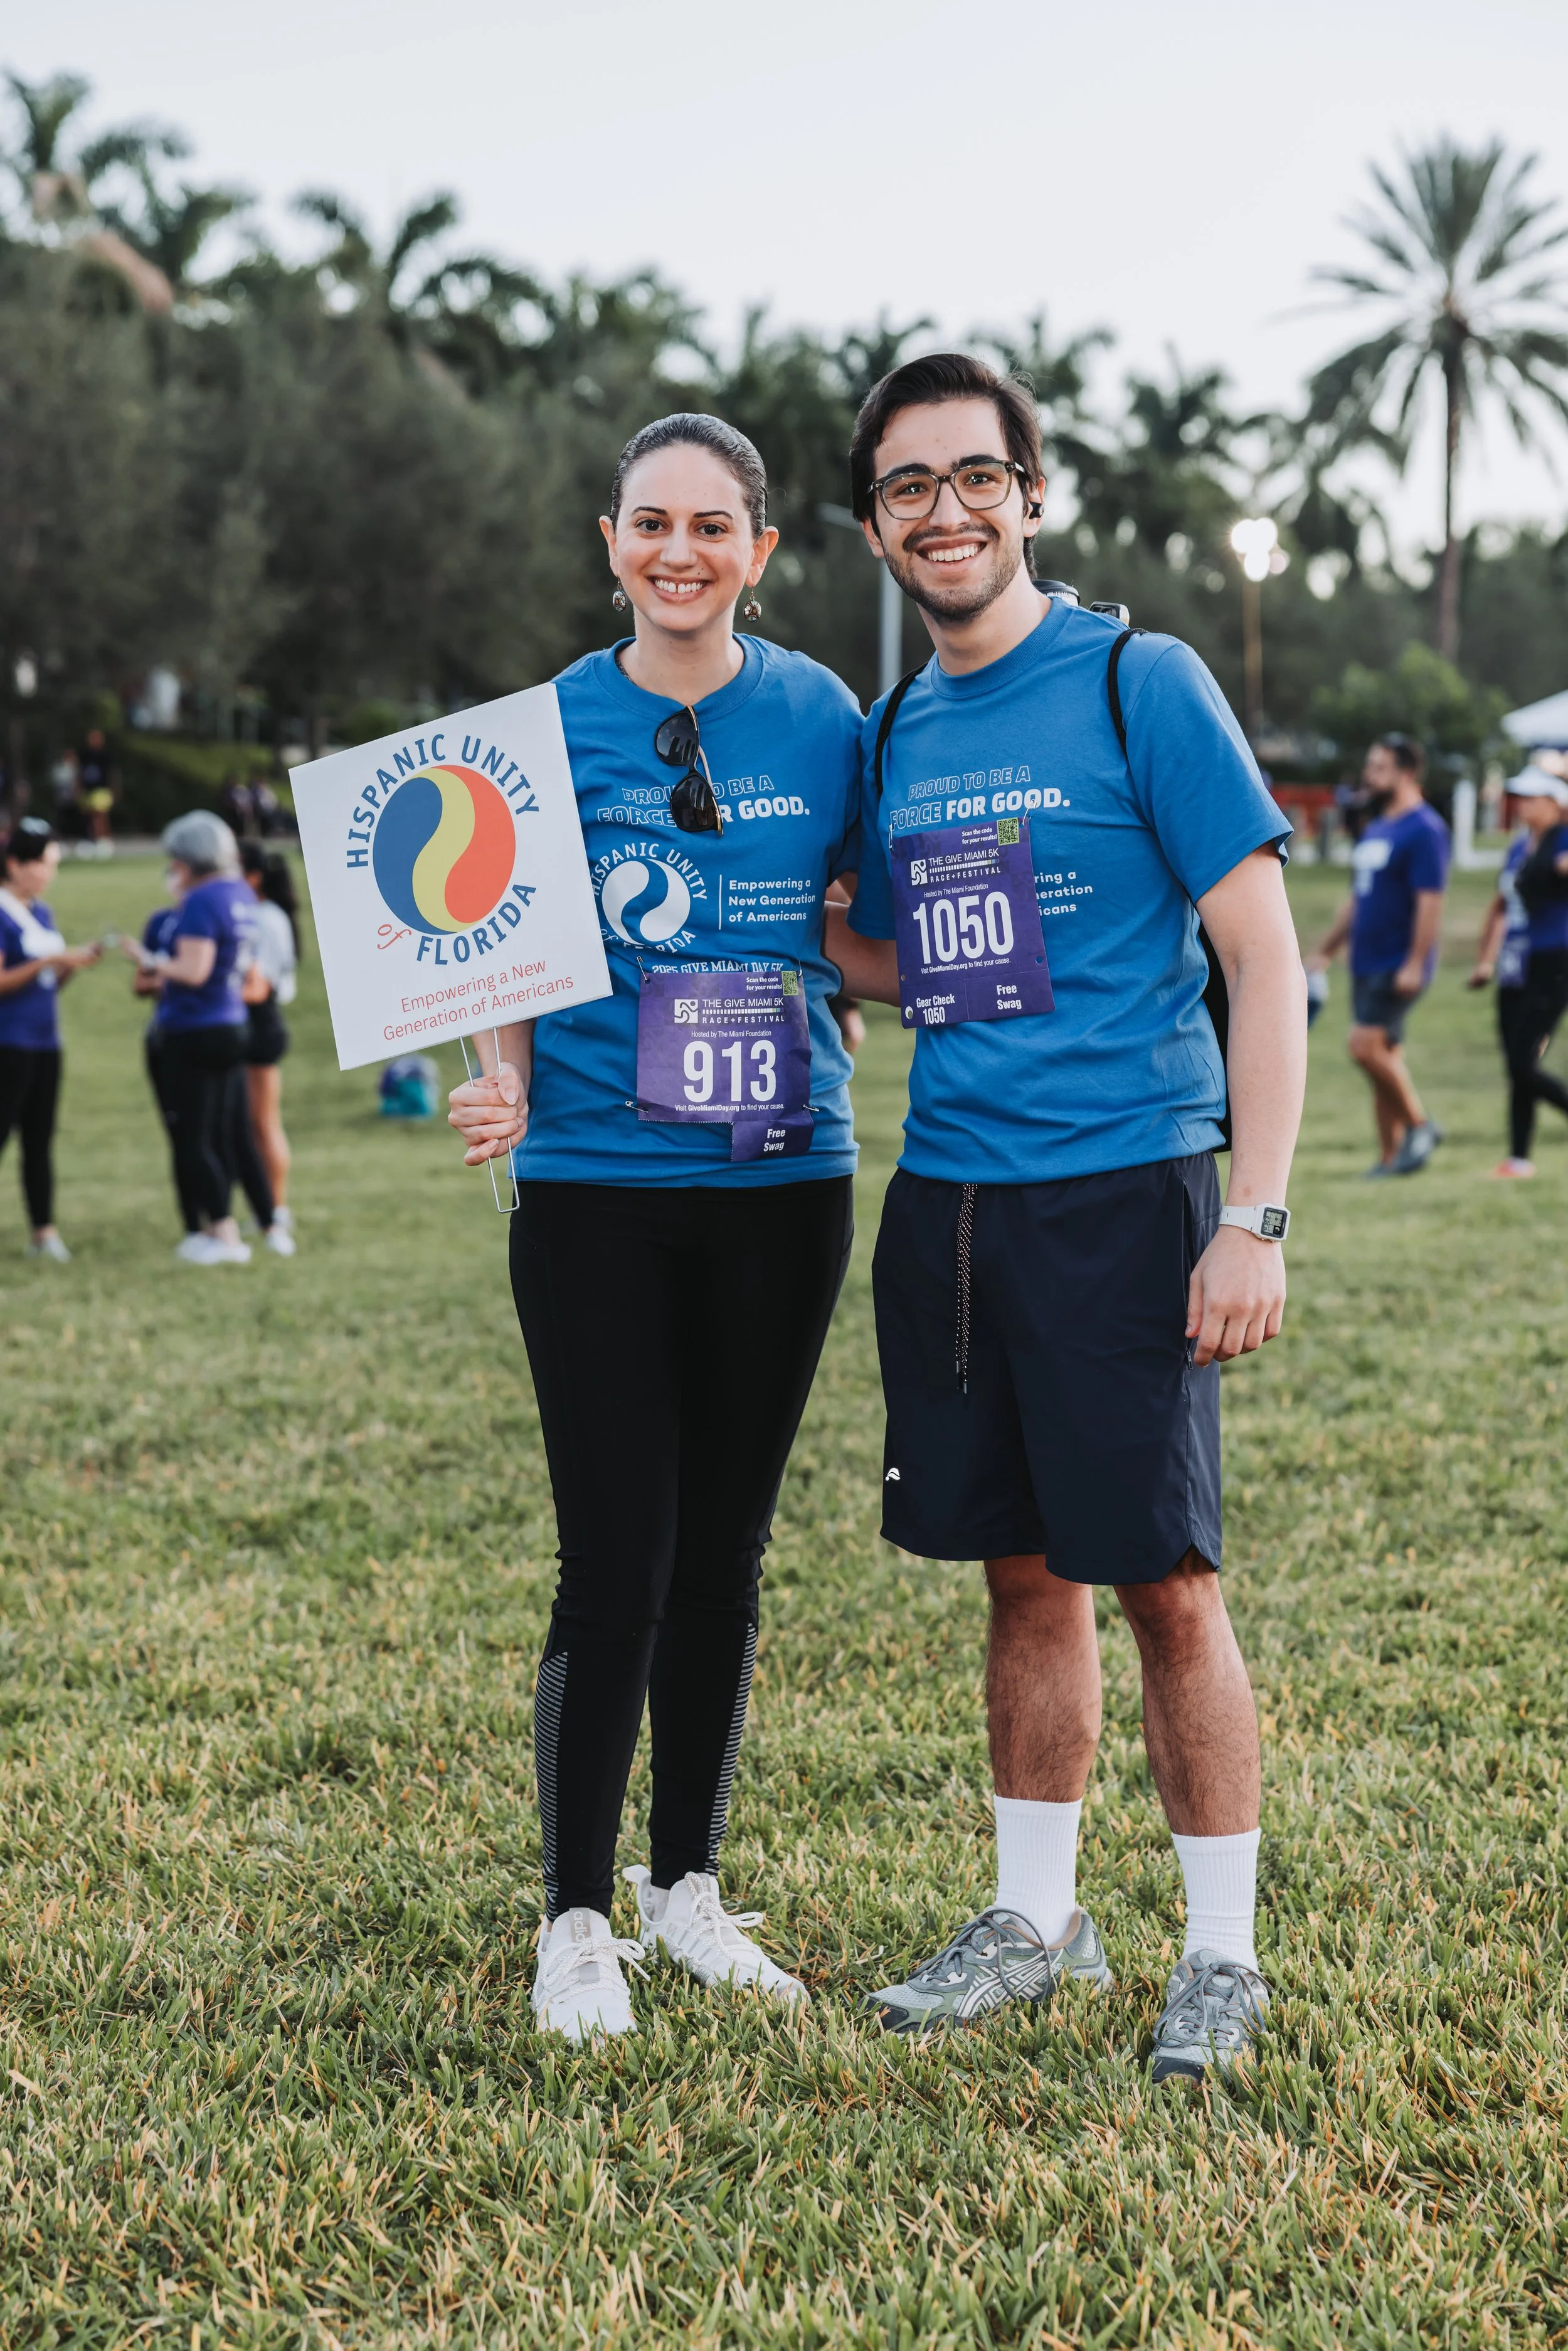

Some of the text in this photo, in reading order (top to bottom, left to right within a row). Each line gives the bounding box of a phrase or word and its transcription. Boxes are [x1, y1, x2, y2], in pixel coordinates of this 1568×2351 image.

[622, 786, 677, 804] PROU
[728, 777, 755, 796] BE
[759, 775, 775, 790] A
[908, 765, 1030, 801] PROUD TO BE A
[347, 734, 539, 868] HISPANIC UNITY
[597, 805, 677, 827] FORCE
[738, 796, 810, 820] GOOD.
[890, 787, 1071, 832] FORCE FOR GOOD.
[980, 834, 997, 842] results!
[928, 847, 999, 866] THE GIVE MIAMI 5K
[666, 849, 707, 900] UNITY
[1067, 871, 1076, 879] a
[729, 878, 811, 892] Empowering a
[923, 889, 938, 898] Hosted
[938, 888, 943, 897] by
[965, 883, 988, 892] Foundation
[729, 893, 815, 906] New Generation
[1036, 885, 1093, 900] eration
[729, 910, 807, 922] of Americans
[1038, 904, 1077, 916] icans
[377, 884, 537, 965] of FLORIDA
[913, 891, 1014, 965] 1050
[681, 962, 709, 974] GIVE
[710, 960, 748, 972] MIAMI
[751, 962, 770, 972] DAY
[770, 963, 783, 972] 5K
[929, 963, 968, 973] GiveMiamiDay.org
[983, 960, 994, 968] your
[401, 960, 546, 1013] Empowering a New
[997, 985, 1017, 995] Free
[384, 976, 573, 1040] Generation of Americans
[702, 997, 783, 1007] THE GIVE MIAMI 5K
[916, 994, 955, 1008] Gear Check
[997, 999, 1022, 1010] Swag
[923, 1006, 946, 1025] 1050
[684, 1040, 776, 1103] 913
[688, 1105, 739, 1113] GiveMiamiDay.org
[767, 1128, 786, 1138] Free
[763, 1142, 785, 1152] Swag
